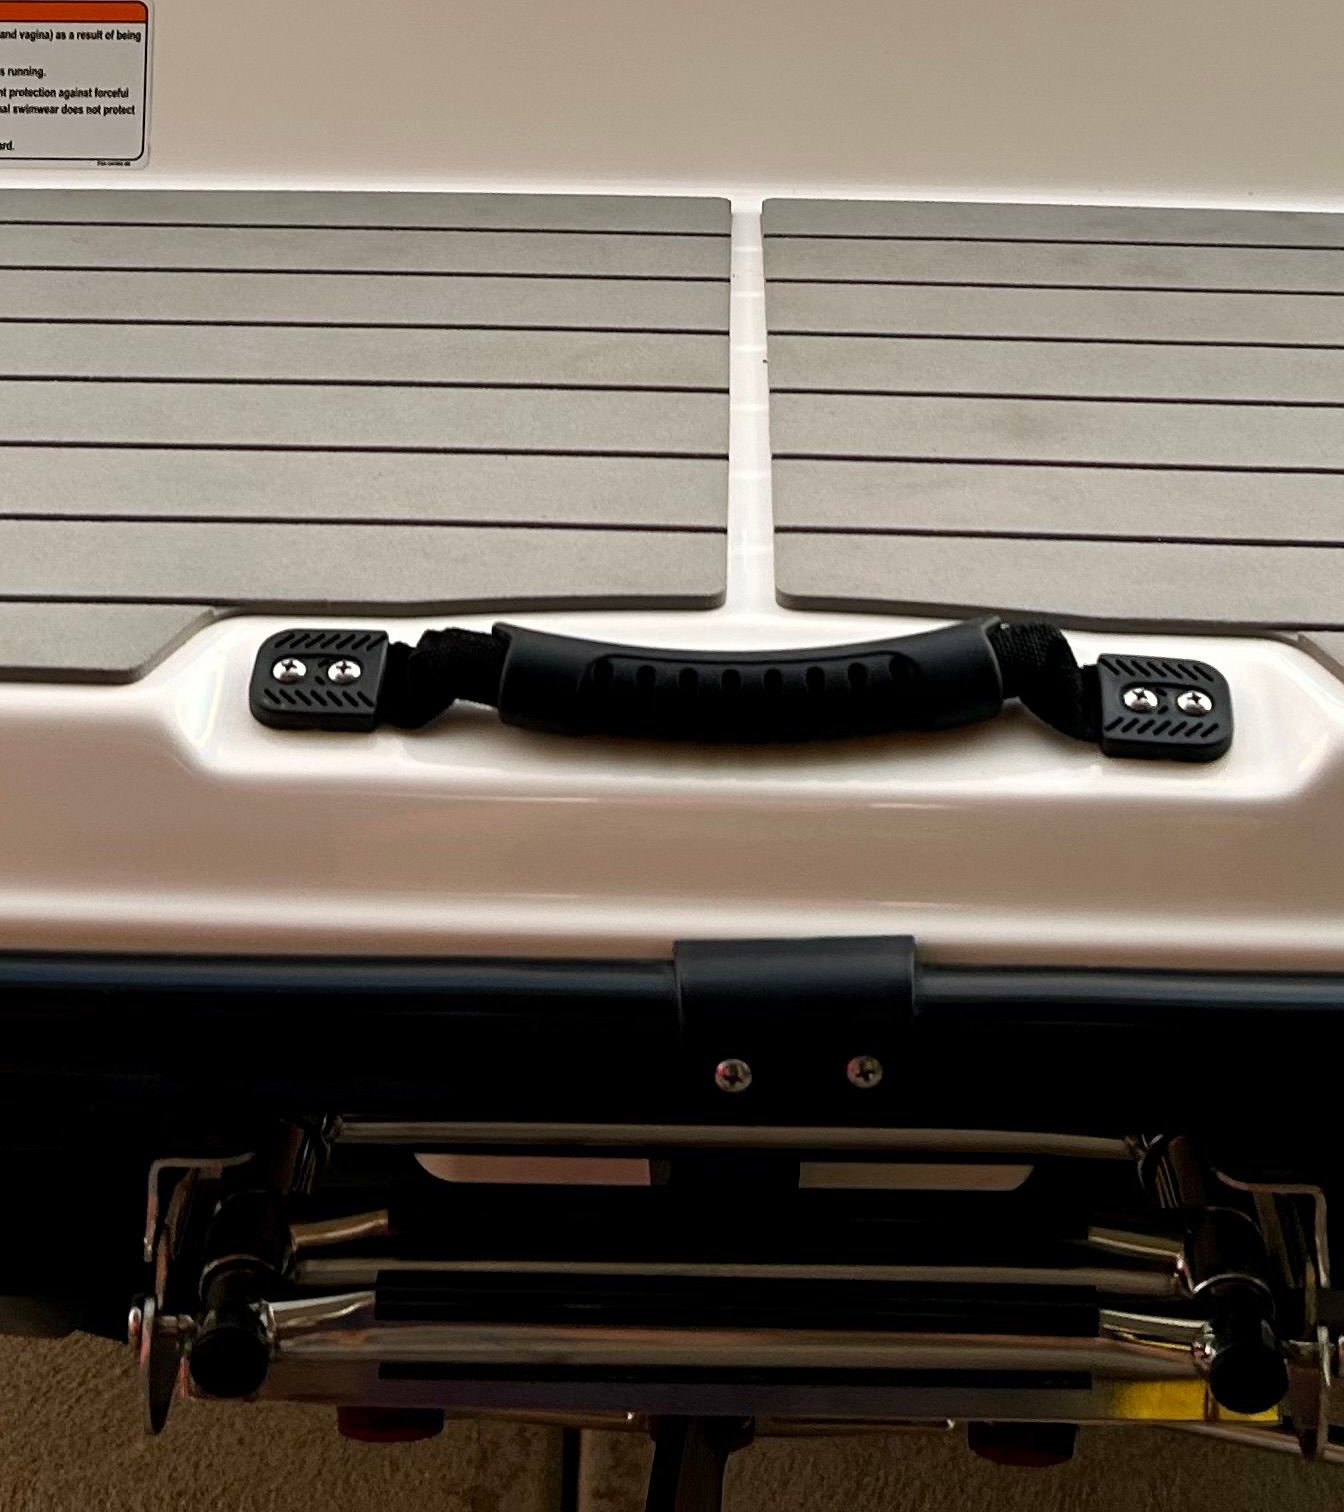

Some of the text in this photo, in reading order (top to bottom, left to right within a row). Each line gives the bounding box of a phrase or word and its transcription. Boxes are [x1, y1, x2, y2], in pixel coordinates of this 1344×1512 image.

[0, 29, 17, 38] and
[55, 31, 66, 39] as
[68, 31, 74, 39] a
[76, 30, 102, 39] result
[104, 29, 114, 39] of
[116, 30, 141, 42] being
[9, 87, 56, 98] protection
[58, 88, 92, 99] against
[94, 87, 128, 97] forceful
[13, 105, 59, 113] swimwear
[61, 104, 83, 114] does
[86, 105, 101, 114] not
[103, 105, 135, 115] protect
